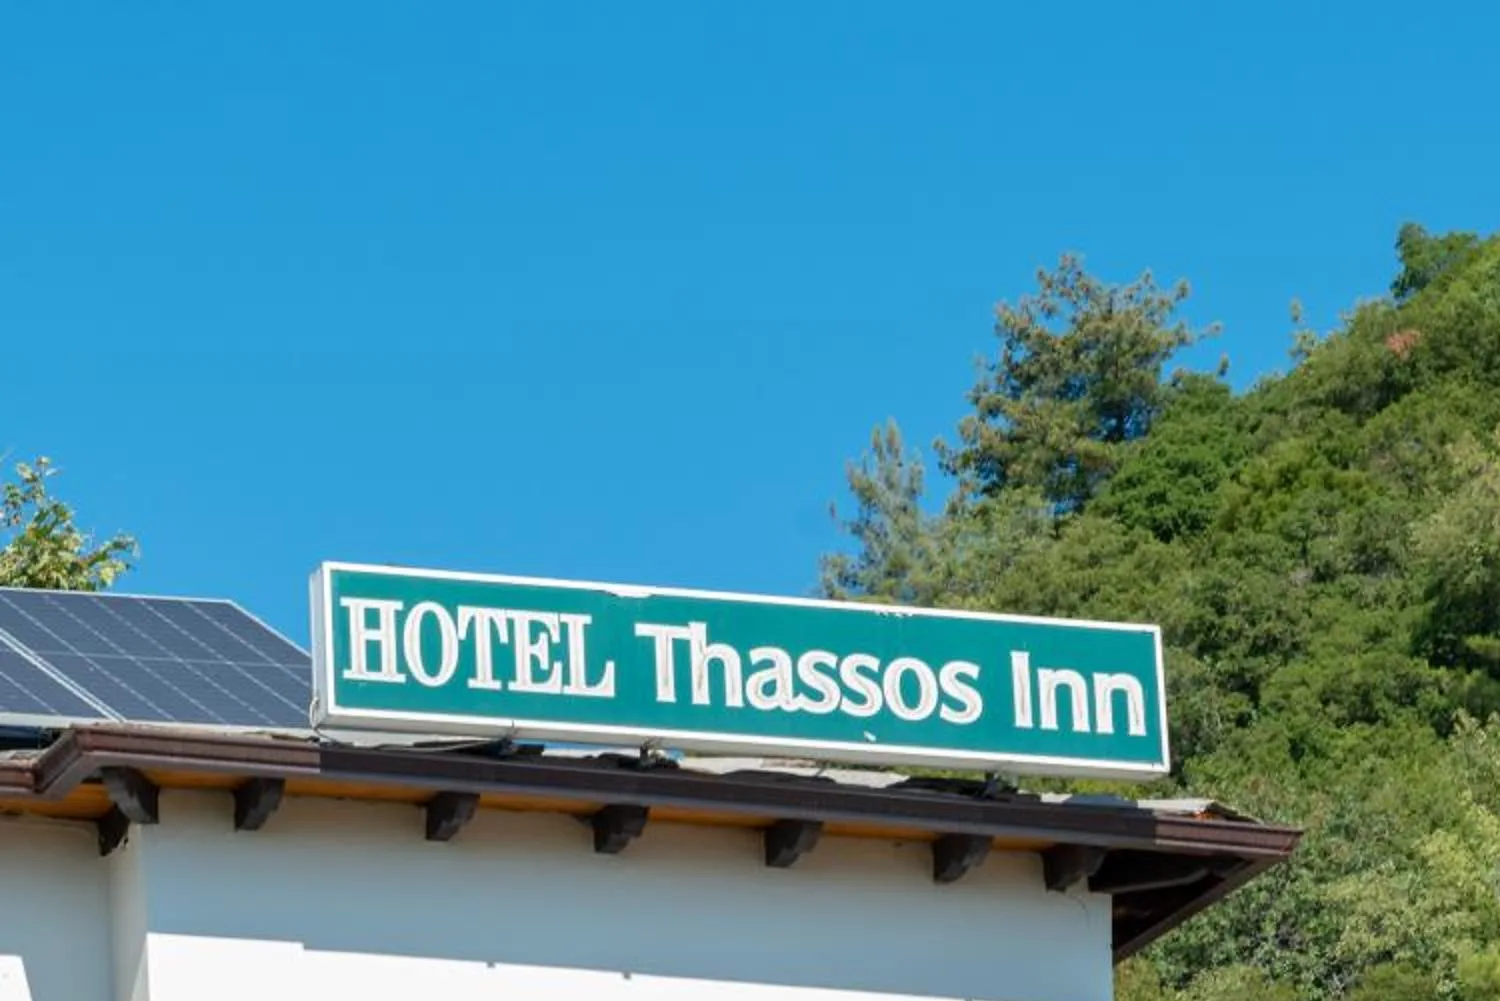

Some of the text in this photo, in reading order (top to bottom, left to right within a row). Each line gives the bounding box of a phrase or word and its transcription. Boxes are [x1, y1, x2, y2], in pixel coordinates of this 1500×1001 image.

[340, 595, 1147, 737] HOTEL Thassos Inn
